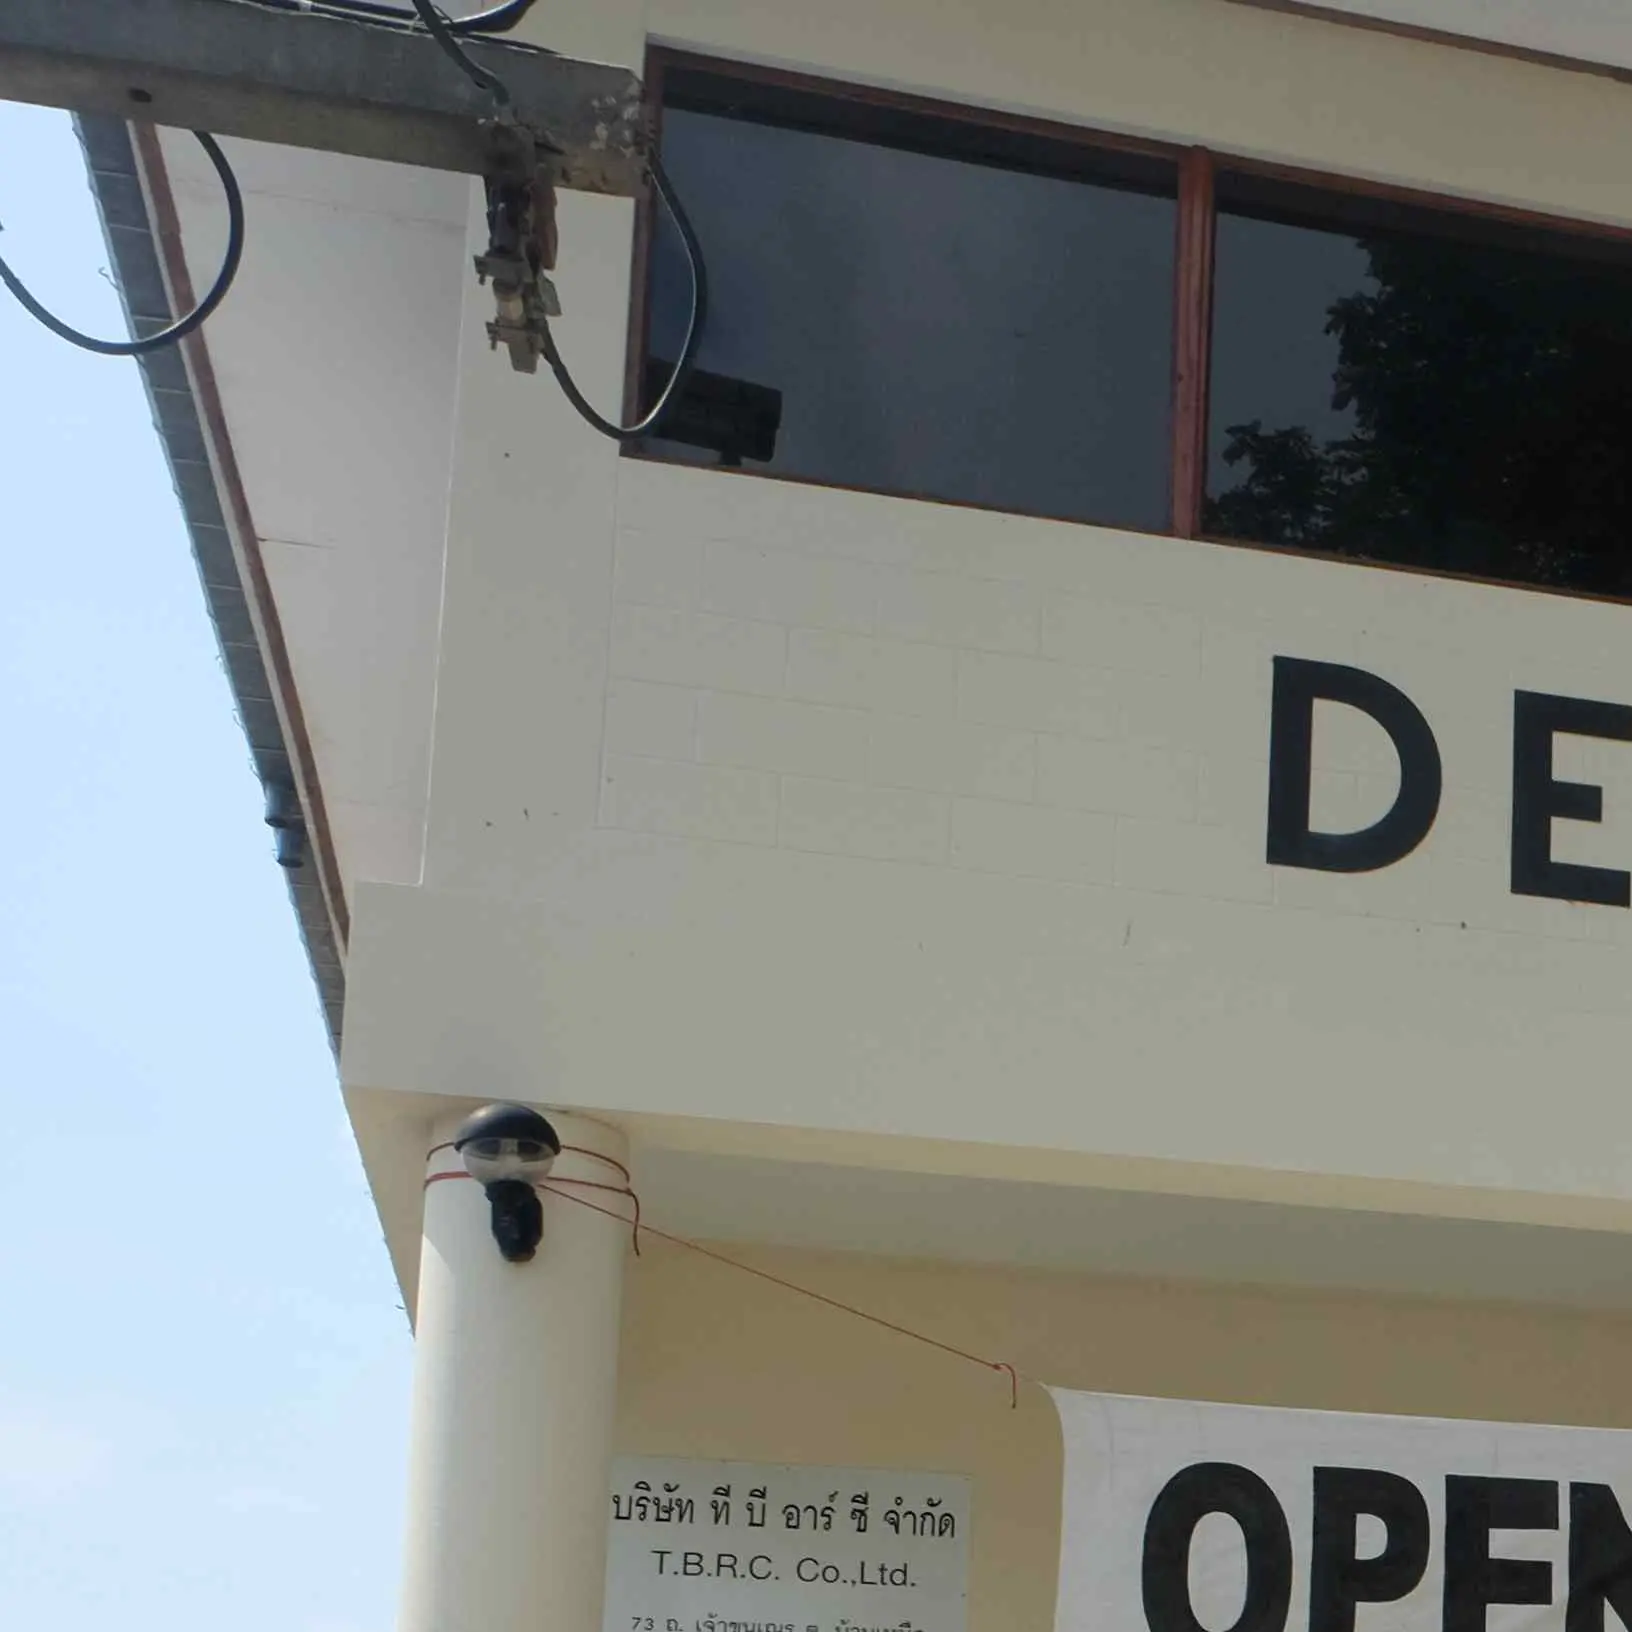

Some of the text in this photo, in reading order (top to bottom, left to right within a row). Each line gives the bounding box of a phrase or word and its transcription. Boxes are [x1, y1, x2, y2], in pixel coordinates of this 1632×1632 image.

[612, 1481, 694, 1523] บริษัท
[711, 1485, 731, 1526] ที
[747, 1486, 767, 1527] บี
[782, 1490, 838, 1531] อาร์
[884, 1496, 955, 1539] จำกัด
[651, 1550, 916, 1588] T.B.R.C. Co.,Ltd.
[631, 1617, 654, 1631] 73
